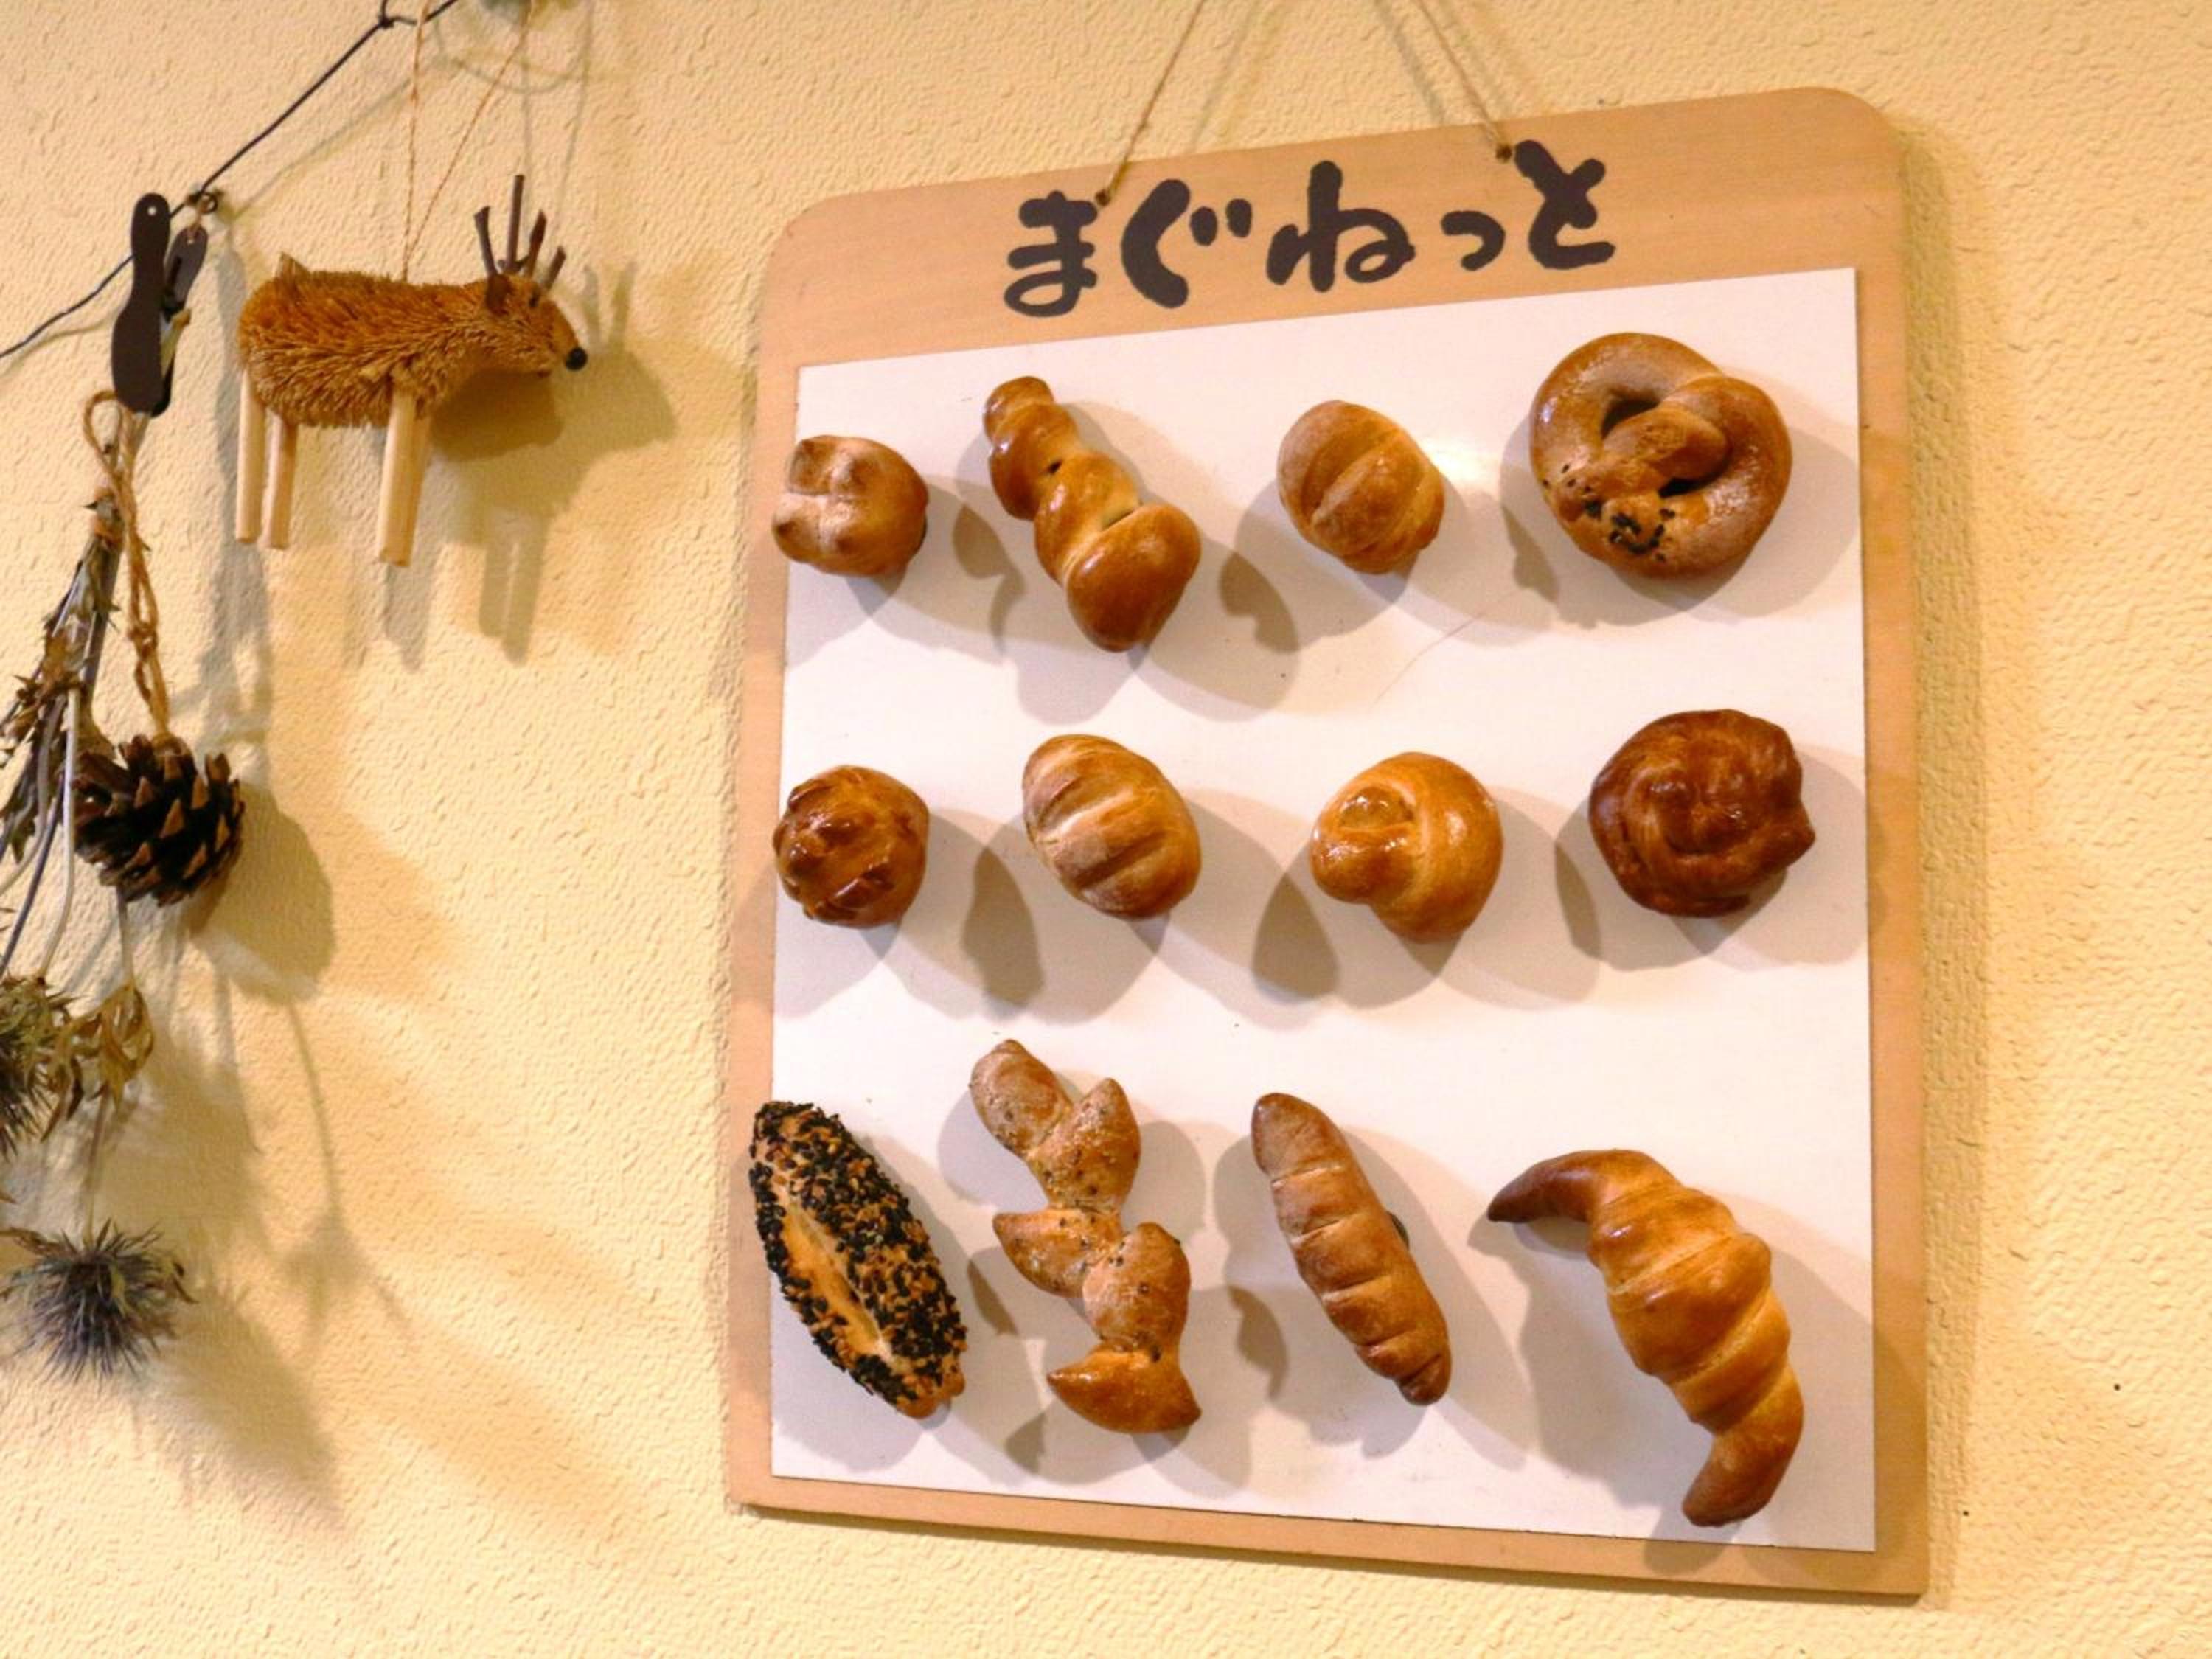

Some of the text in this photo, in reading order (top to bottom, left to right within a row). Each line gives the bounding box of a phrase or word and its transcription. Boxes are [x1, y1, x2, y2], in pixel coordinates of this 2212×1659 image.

[1004, 139, 1616, 317] まぐねっと
